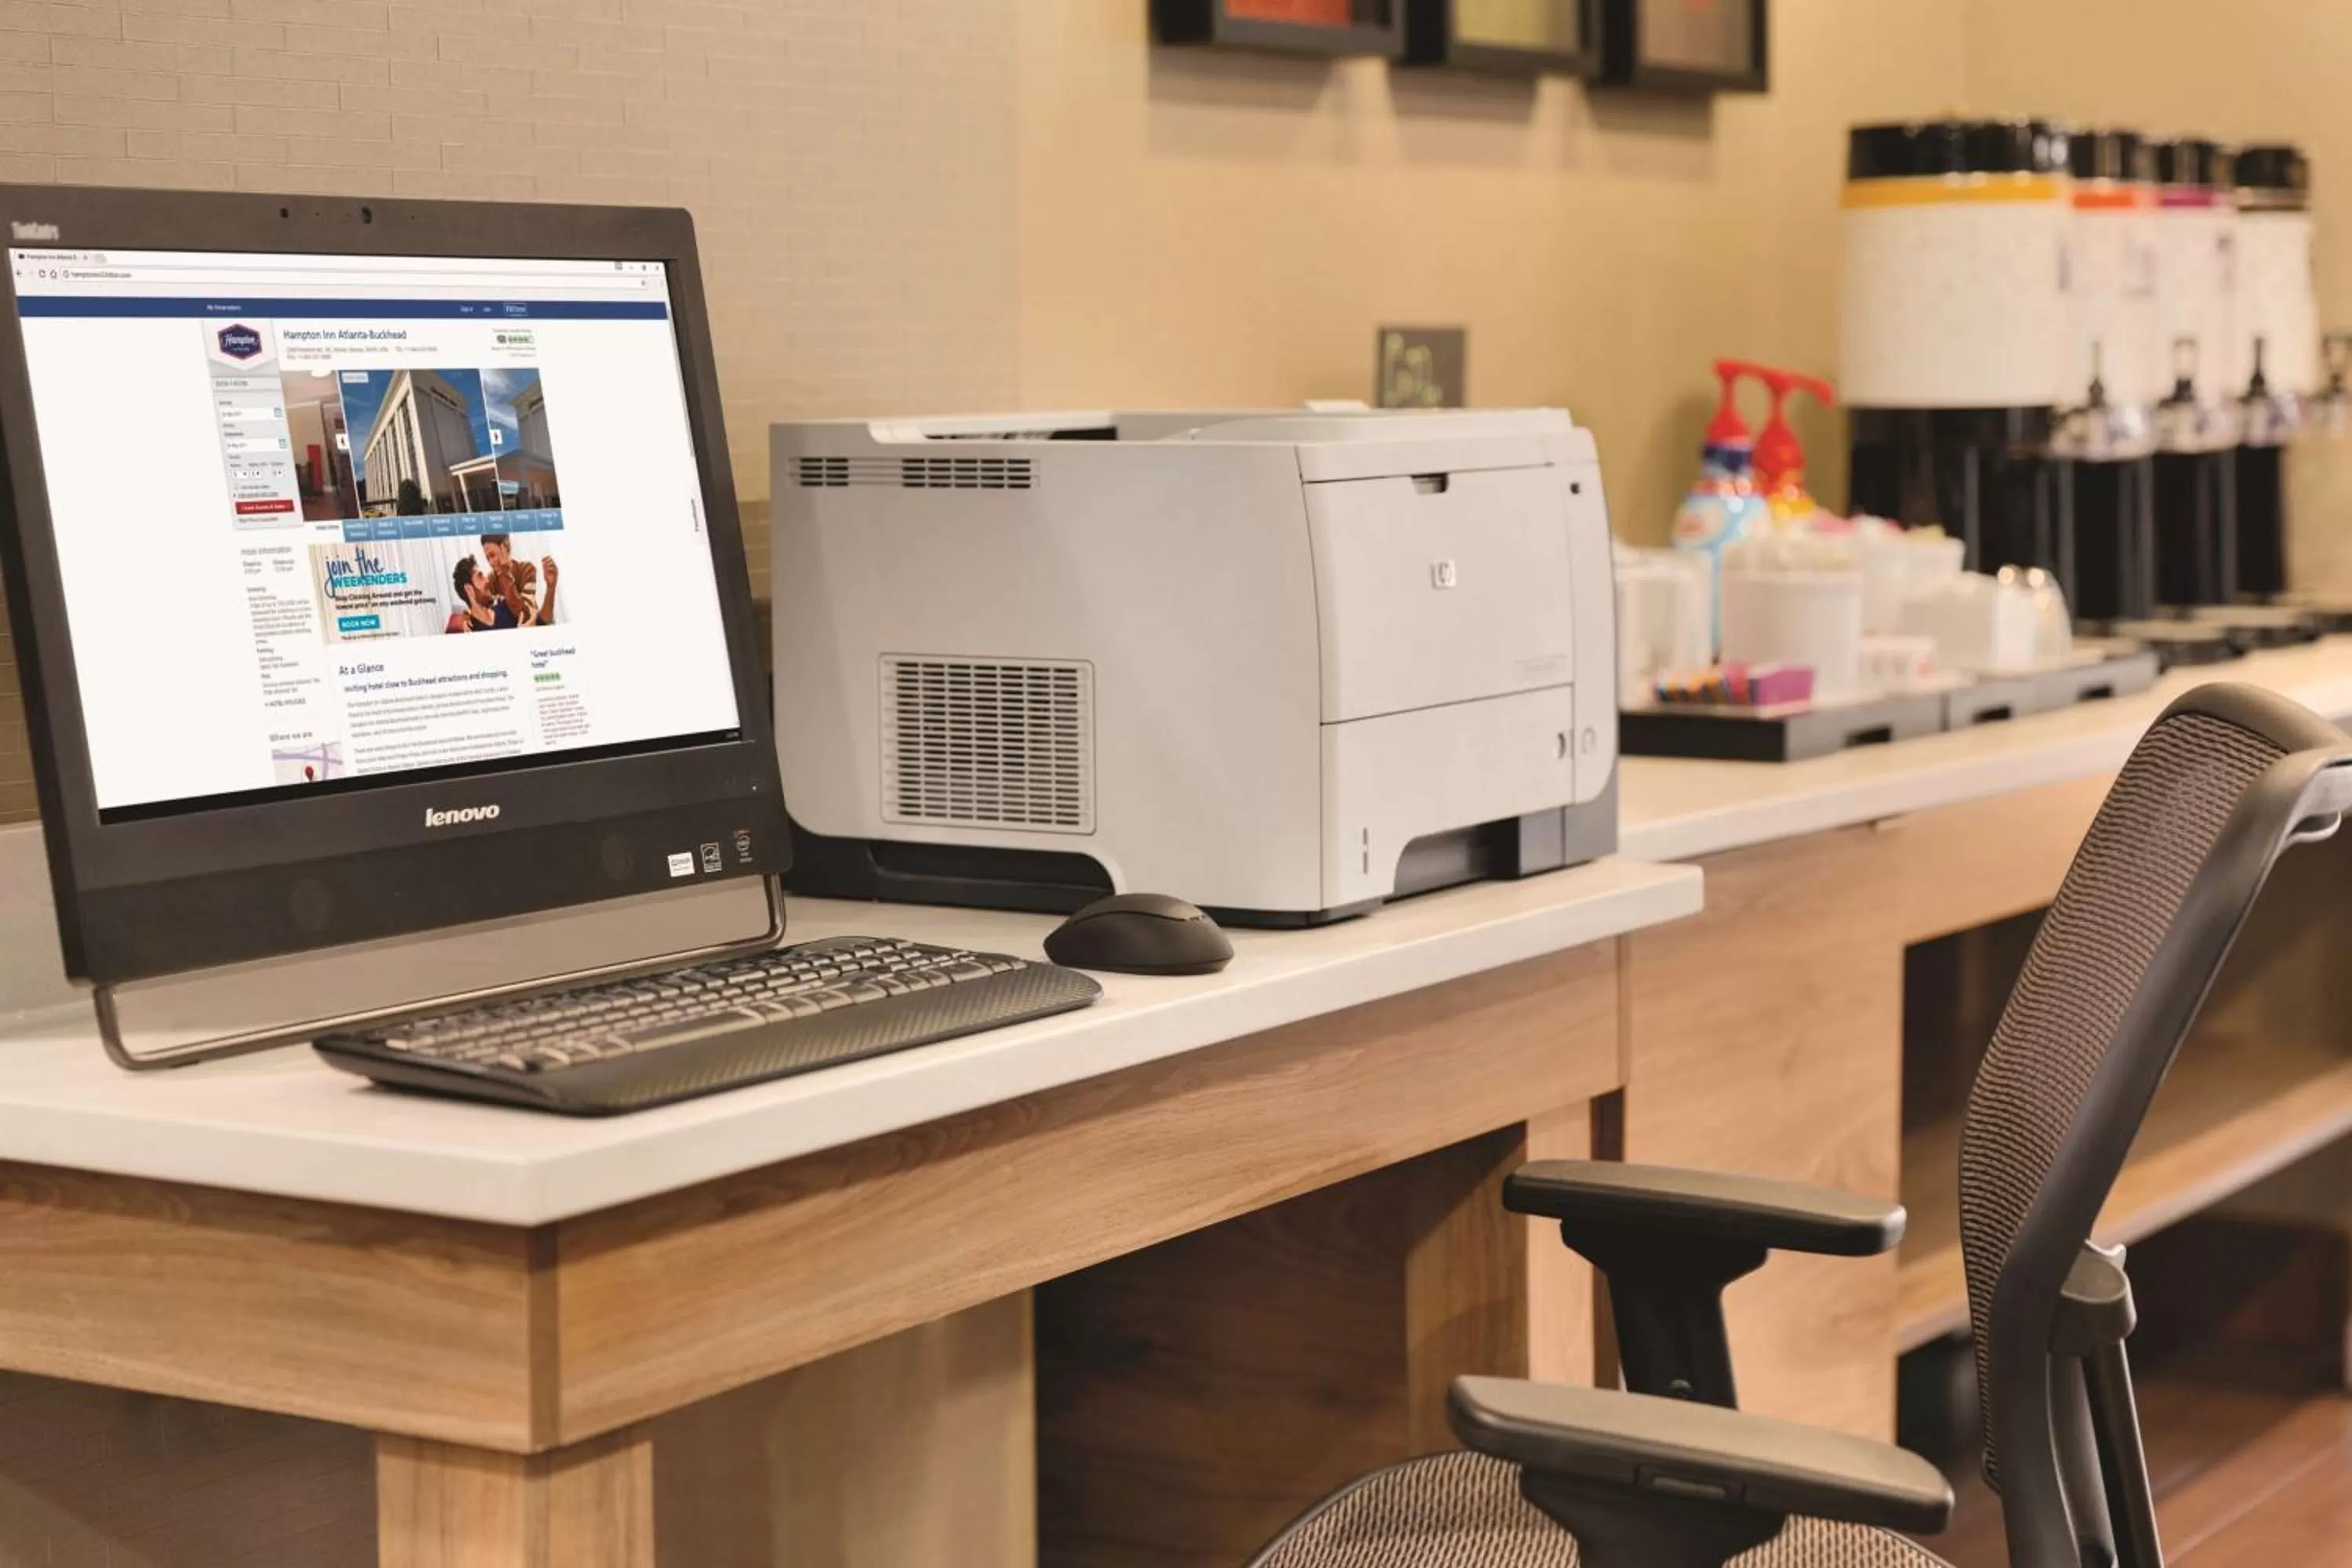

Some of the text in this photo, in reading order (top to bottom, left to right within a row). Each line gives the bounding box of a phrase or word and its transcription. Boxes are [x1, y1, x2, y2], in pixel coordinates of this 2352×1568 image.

[283, 329, 321, 342] Hampton
[322, 329, 336, 339] Inn
[354, 546, 383, 576] the
[333, 572, 407, 589] WEEKENDERS
[339, 664, 348, 675] At
[357, 662, 384, 673] Glance
[408, 677, 437, 686] Buckhead
[425, 804, 500, 828] lenovo
